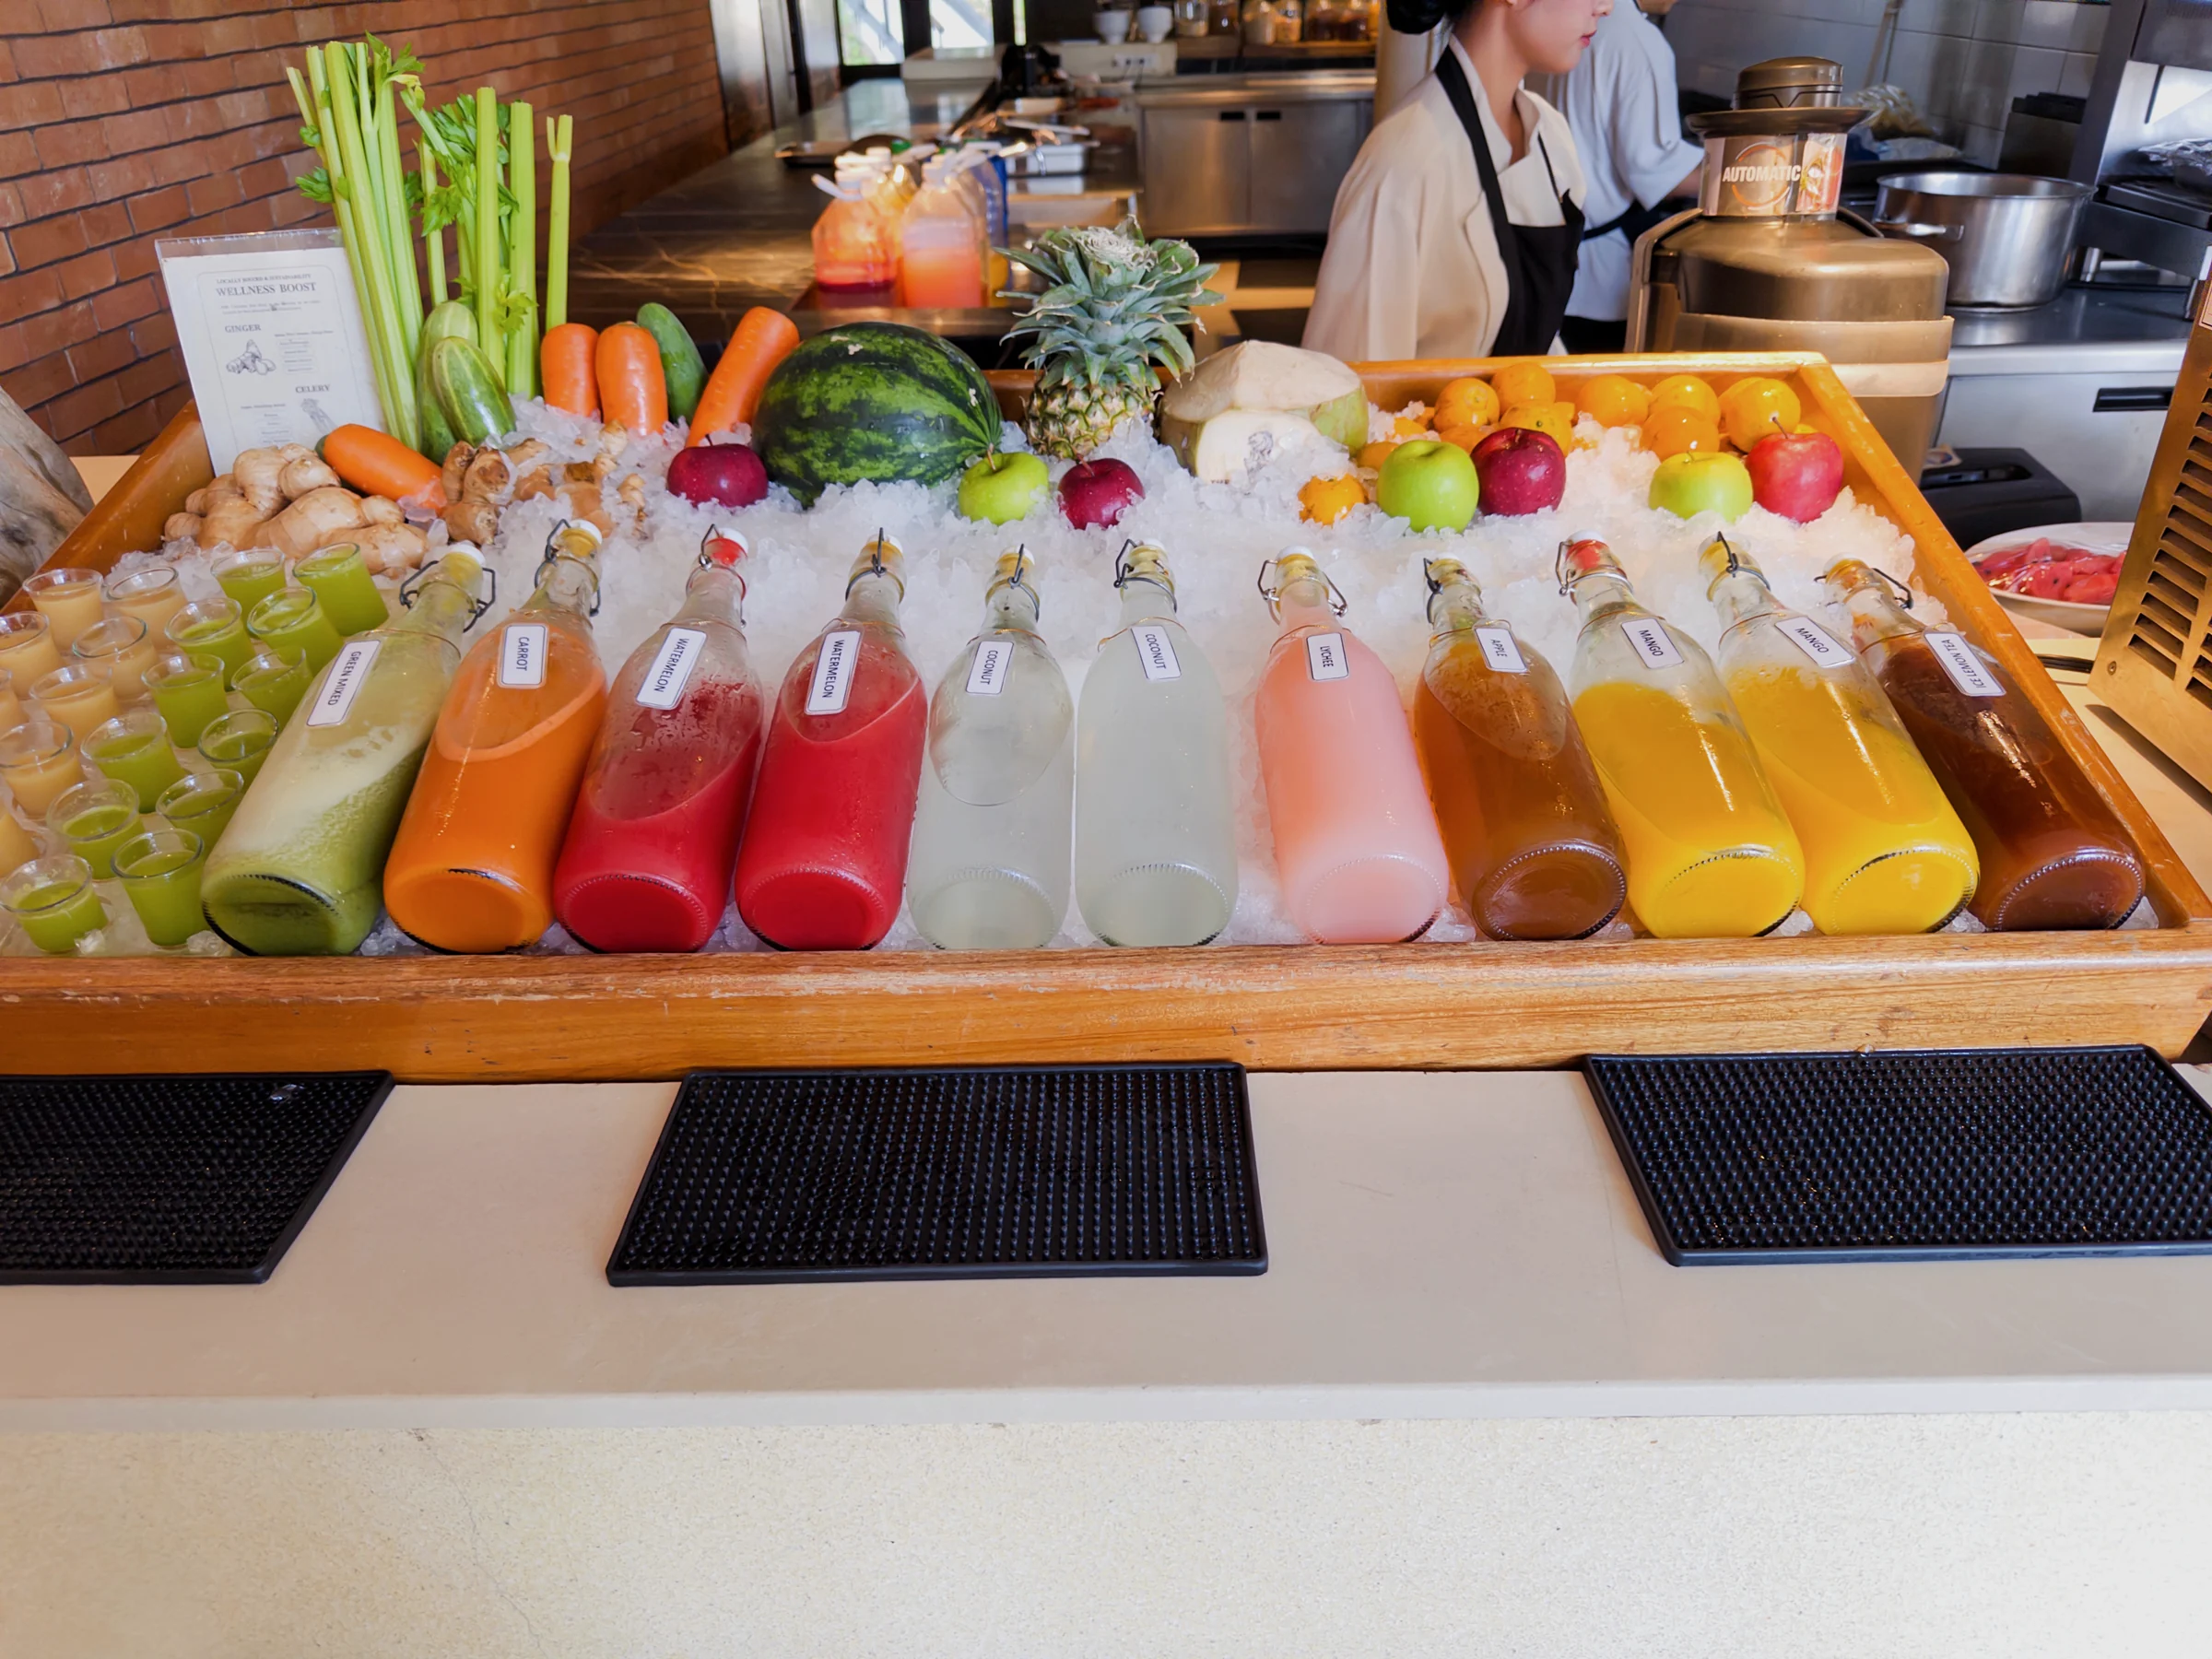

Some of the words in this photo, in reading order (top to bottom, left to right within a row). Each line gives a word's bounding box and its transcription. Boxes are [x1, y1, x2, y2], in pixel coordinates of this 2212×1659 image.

[1722, 165, 1801, 182] AUTOMATIC
[216, 284, 276, 296] WELLNESS
[279, 282, 316, 293] BOOST
[224, 324, 262, 333] GINGER
[295, 384, 330, 394] CELERY
[1145, 633, 1166, 669] COCONUT
[1490, 639, 1508, 657] APPLE
[1638, 629, 1664, 656] MANGO
[1794, 628, 1829, 653] MANGO
[1941, 639, 1958, 652] TEA
[341, 651, 361, 677] GREEN
[516, 636, 530, 671] CARROT
[653, 638, 689, 692] WATERMELON
[1320, 645, 1334, 667] LYCHEE
[1950, 652, 1977, 677] LEMON
[822, 640, 845, 698] WATERMELON
[980, 650, 998, 685] COCONUT
[327, 678, 348, 706] MIXED
[1970, 678, 1987, 688] ICE
